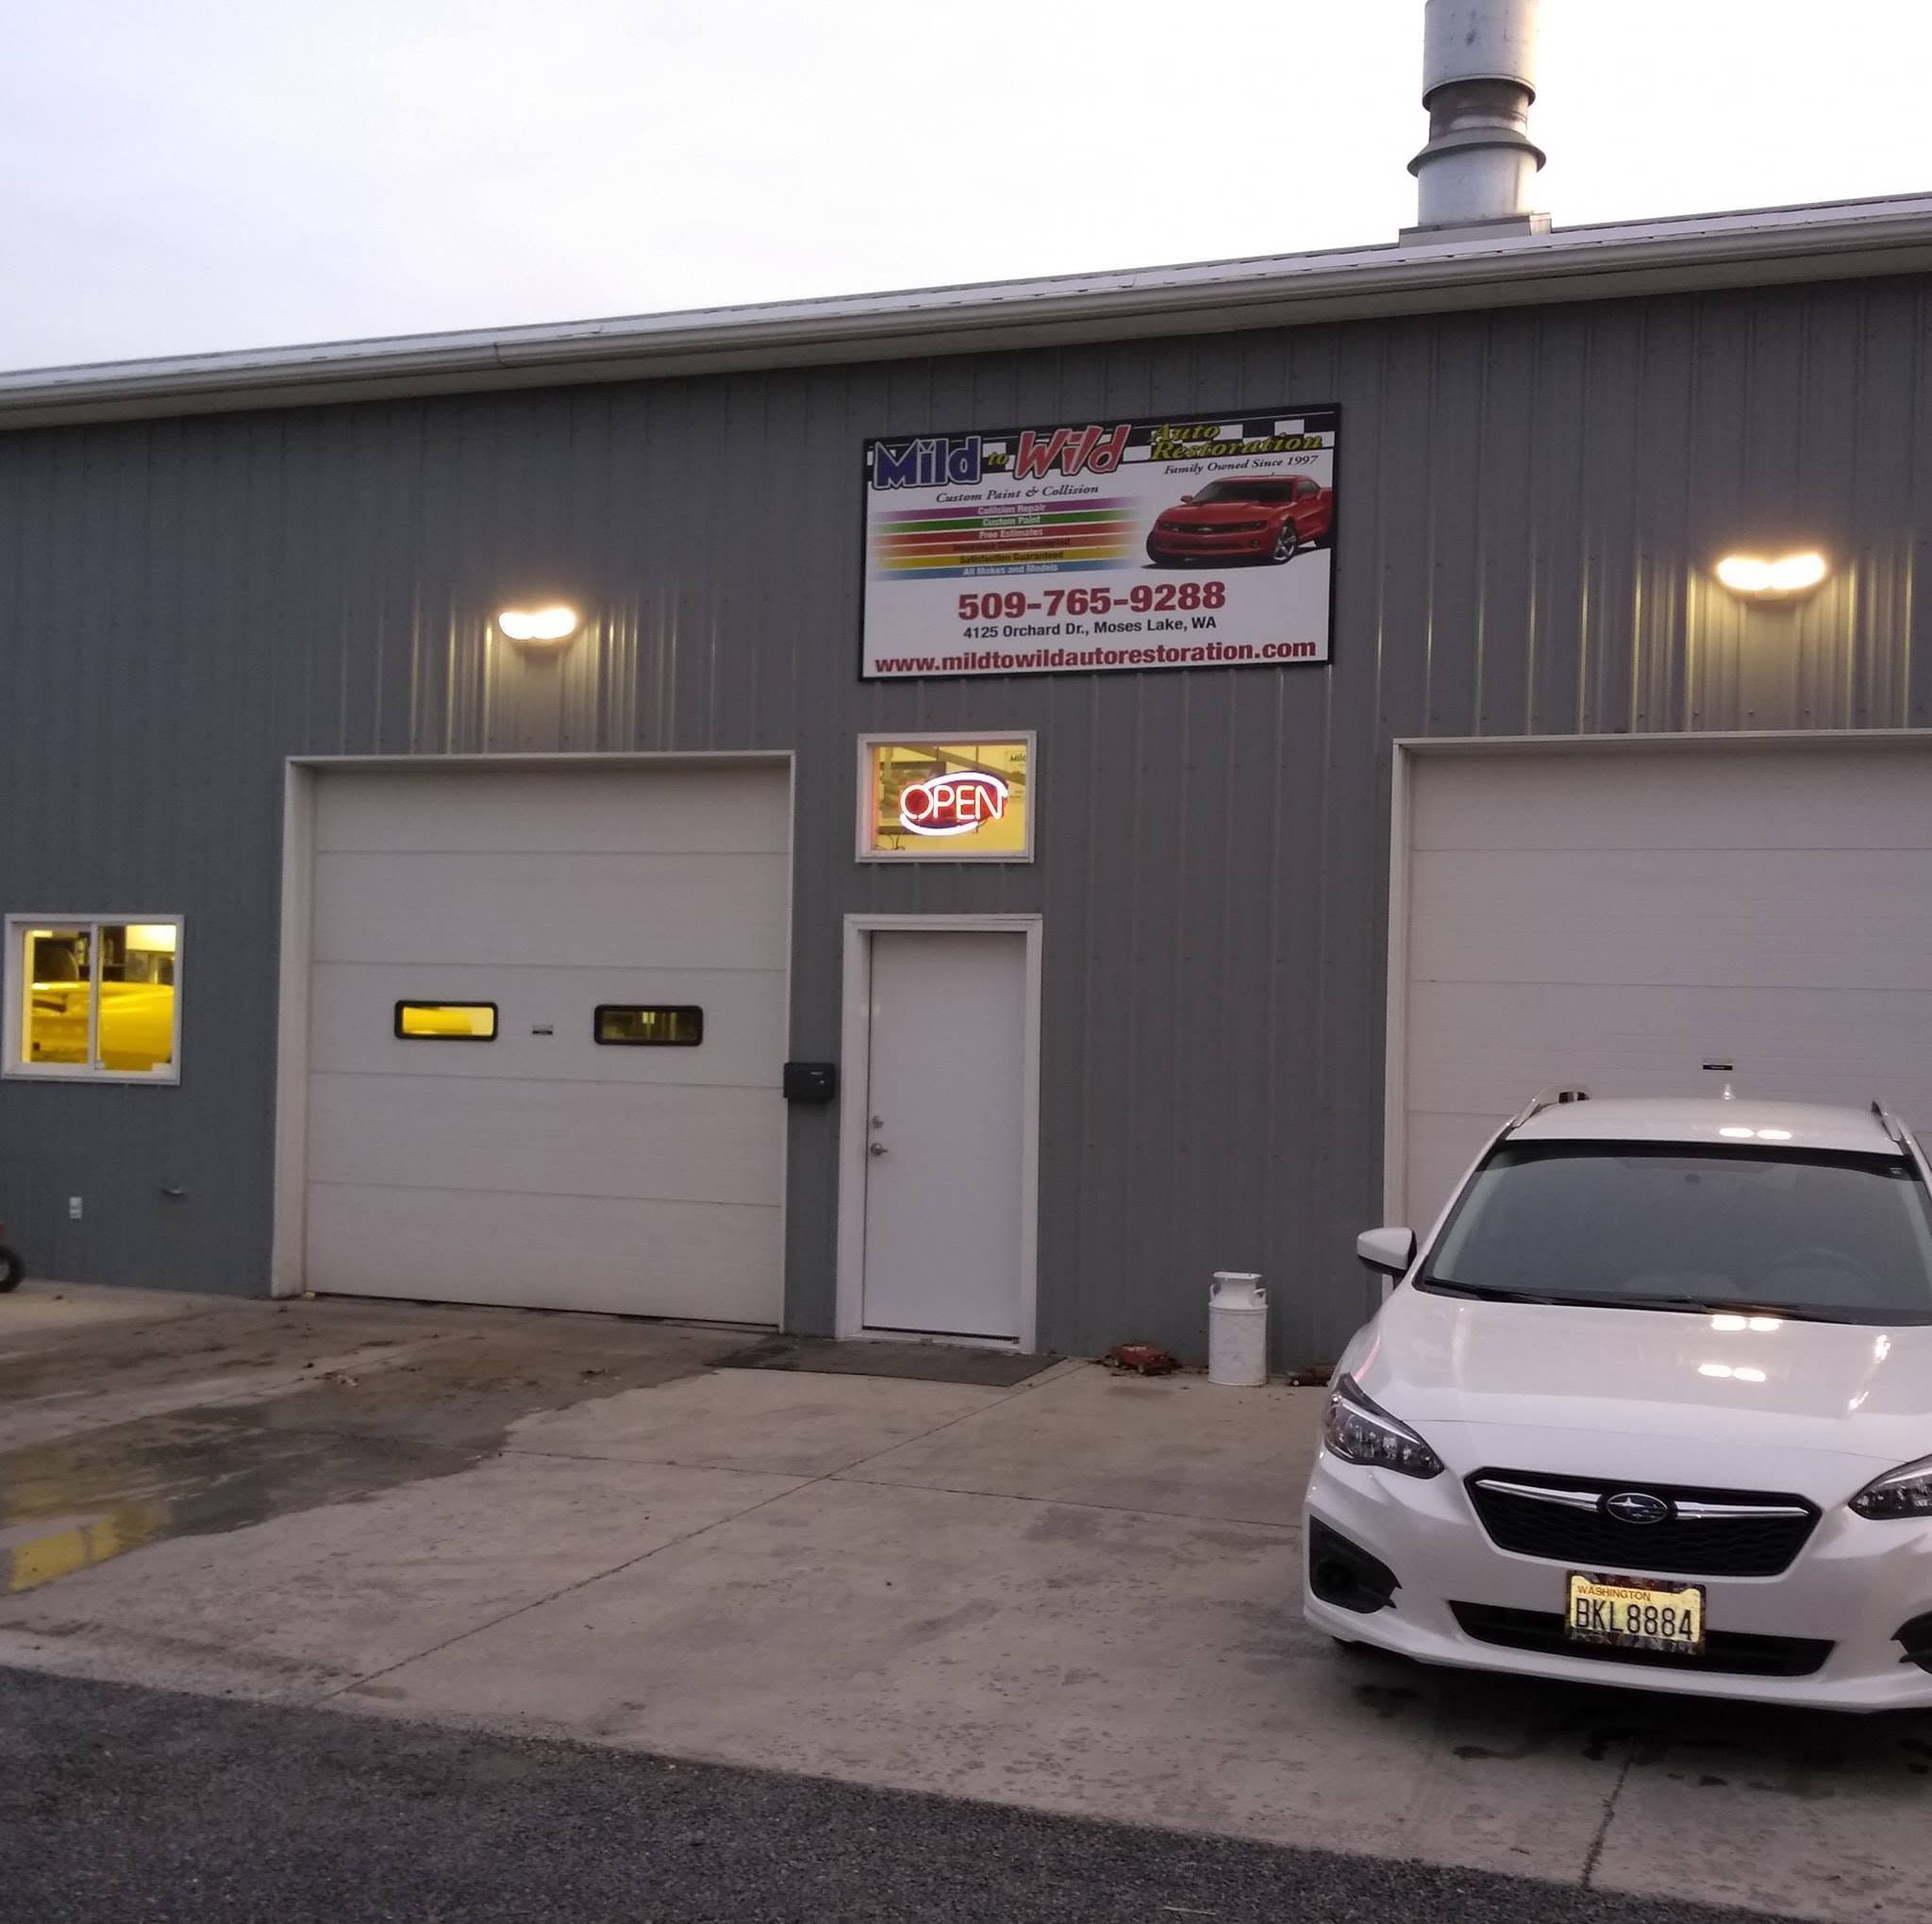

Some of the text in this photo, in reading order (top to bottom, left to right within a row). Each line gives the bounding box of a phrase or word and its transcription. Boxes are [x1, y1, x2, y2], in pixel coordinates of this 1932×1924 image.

[1151, 423, 1220, 442] Auto
[1149, 432, 1323, 460] Restoration
[873, 425, 1131, 489] Mild to Wild
[1164, 455, 1319, 476] Family Owned Since 1997
[936, 484, 1099, 504] Custom Paint & Collision
[977, 503, 1046, 515] Collision Repair
[982, 515, 1041, 527] Custom Paint
[979, 528, 1043, 539] Free Estimates
[963, 563, 1058, 576] All Makes and Models
[958, 581, 1225, 620] 509-765-9288
[963, 616, 1217, 639] 4125 Orchard Dr., Moses Lake, WA
[875, 641, 1317, 673] www.mildtowildautorestoration.com
[900, 784, 1006, 820] OPEN
[1577, 1585, 1651, 1601] WASHINGTON
[1576, 1597, 1693, 1641] BKL8884
